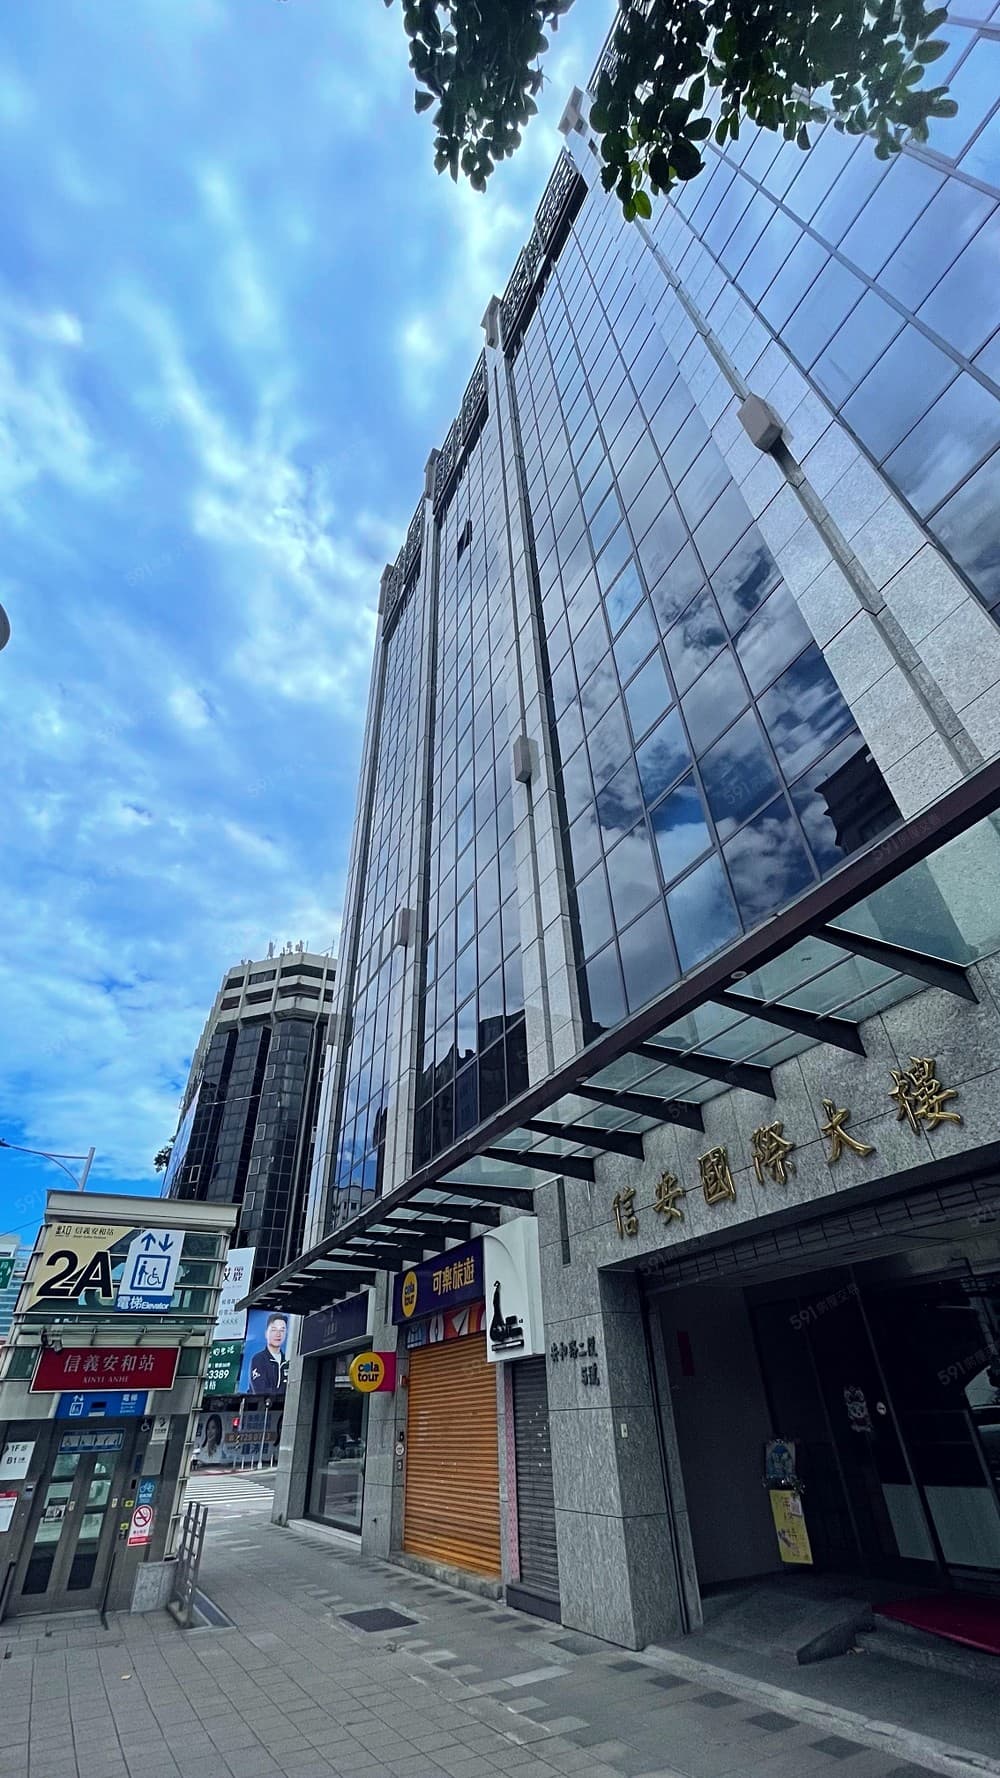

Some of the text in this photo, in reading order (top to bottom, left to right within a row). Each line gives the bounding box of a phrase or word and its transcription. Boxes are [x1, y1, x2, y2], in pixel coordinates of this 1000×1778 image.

[611, 1055, 964, 1240] 信安國際大樓
[36, 1249, 113, 1298] 2A
[432, 1255, 475, 1296] 可樂旅遊
[117, 1295, 143, 1310] 電梯
[141, 1302, 170, 1310] Elevator
[63, 1353, 156, 1373] 信義安和站
[358, 1361, 379, 1372] cola
[83, 1376, 129, 1384] XINYI ANHE
[358, 1373, 380, 1383] tour
